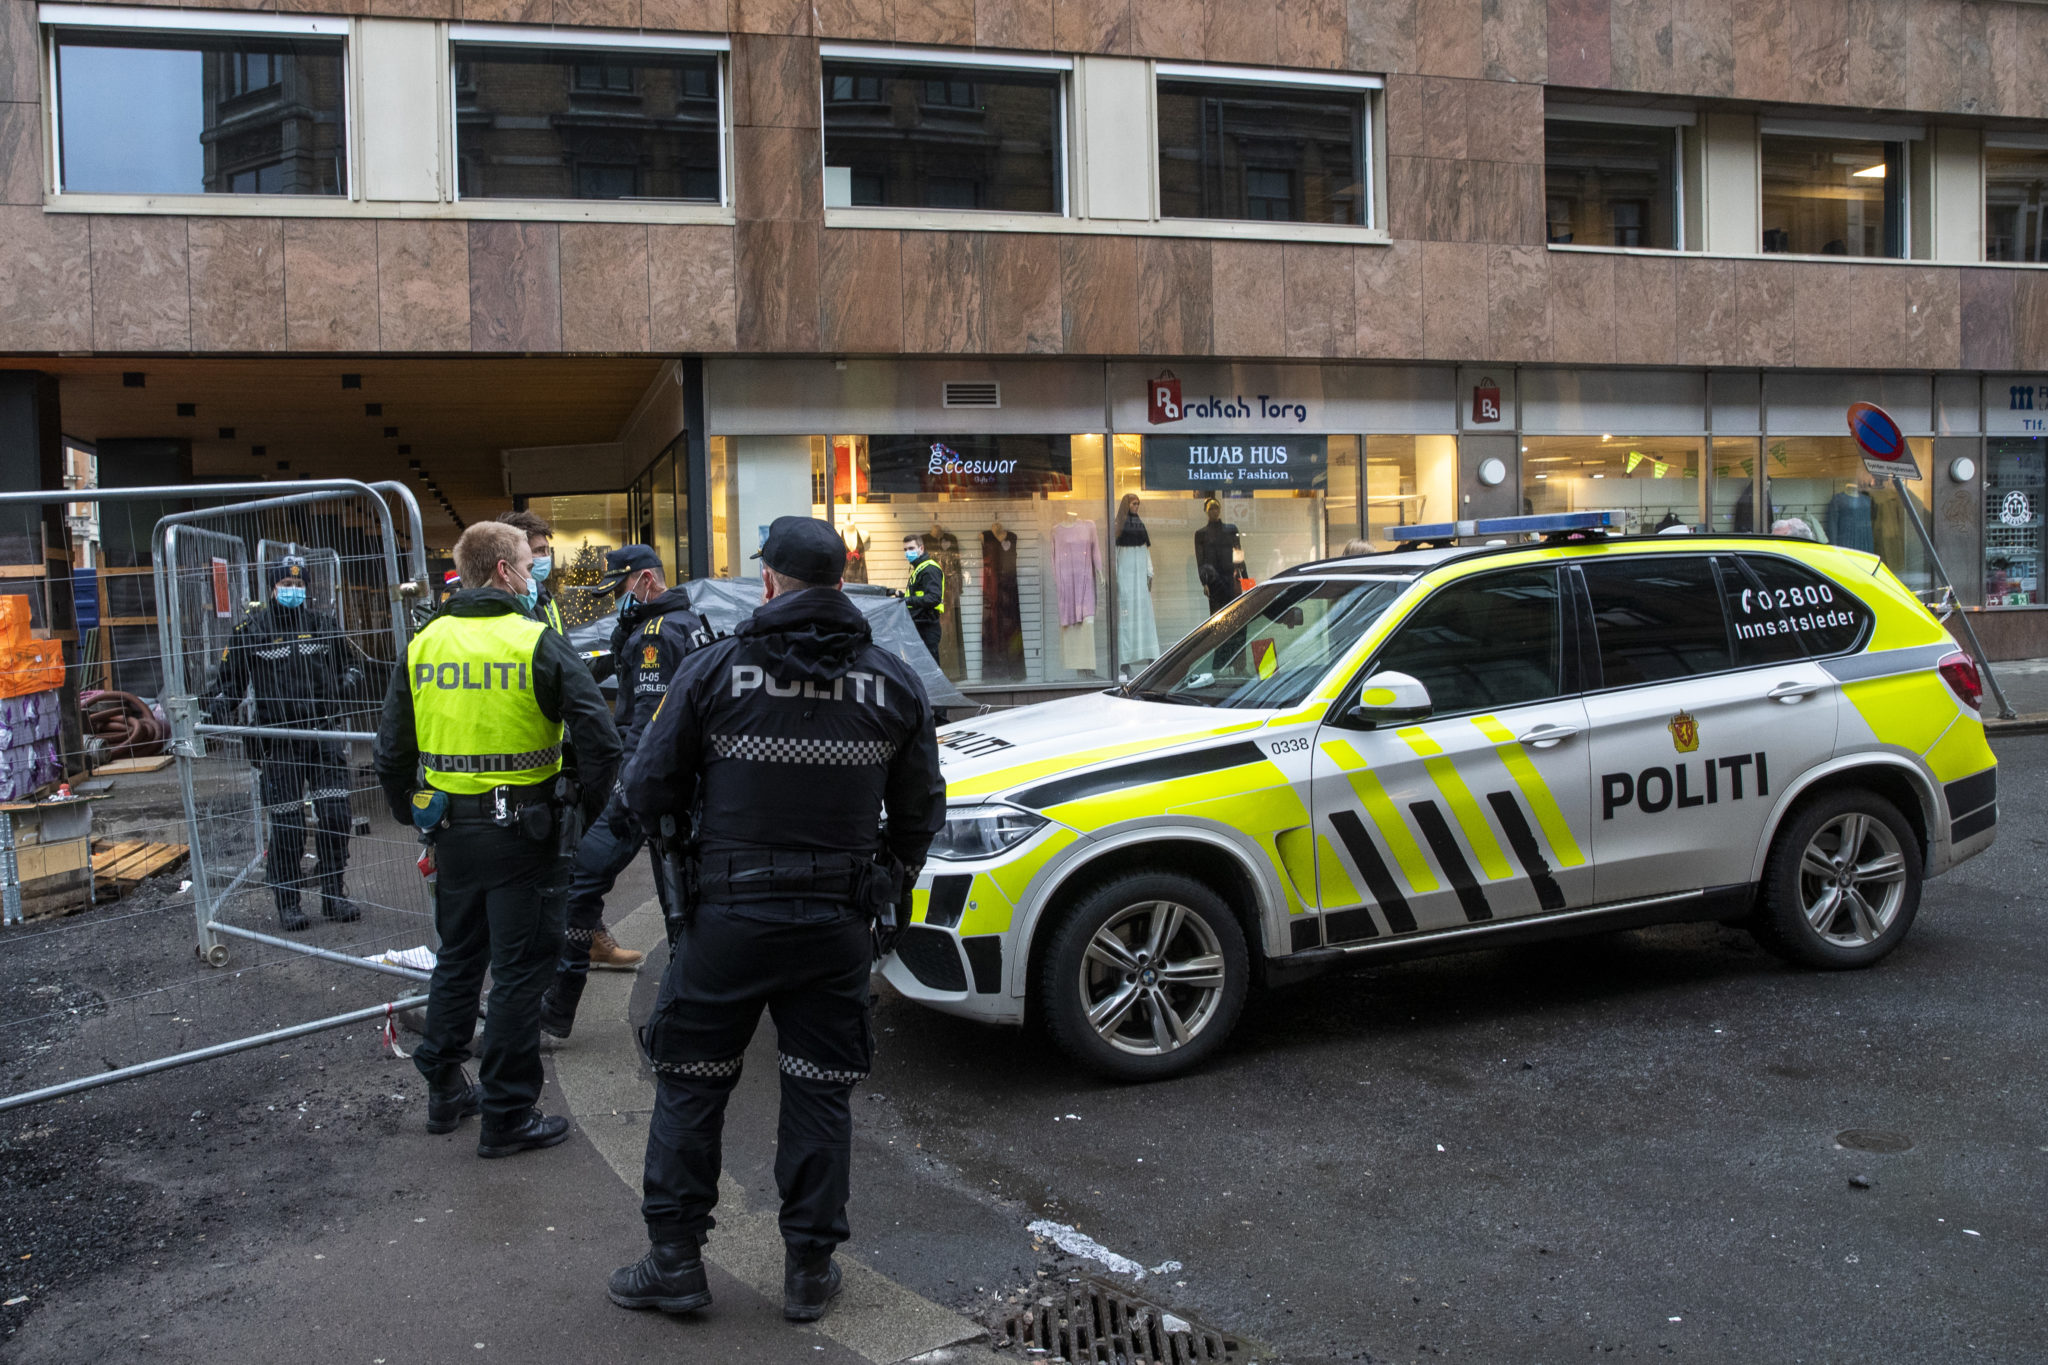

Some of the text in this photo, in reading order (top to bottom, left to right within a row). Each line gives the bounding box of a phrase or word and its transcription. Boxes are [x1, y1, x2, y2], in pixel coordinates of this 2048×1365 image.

[1258, 395, 1307, 422] Torg
[2023, 419, 2046, 430] Tlf.
[1189, 446, 1288, 464] HIJAB HUS
[1187, 468, 1289, 480] Islamic Fashion
[1758, 584, 1833, 610] 02800
[1735, 610, 1854, 639] Innsatsleder
[415, 662, 527, 690] POLITI
[639, 672, 660, 682] U-05
[732, 665, 885, 707] POLITI
[1271, 737, 1309, 755] 0338
[441, 754, 506, 773] POLITI
[1602, 751, 1769, 821] POLITI
